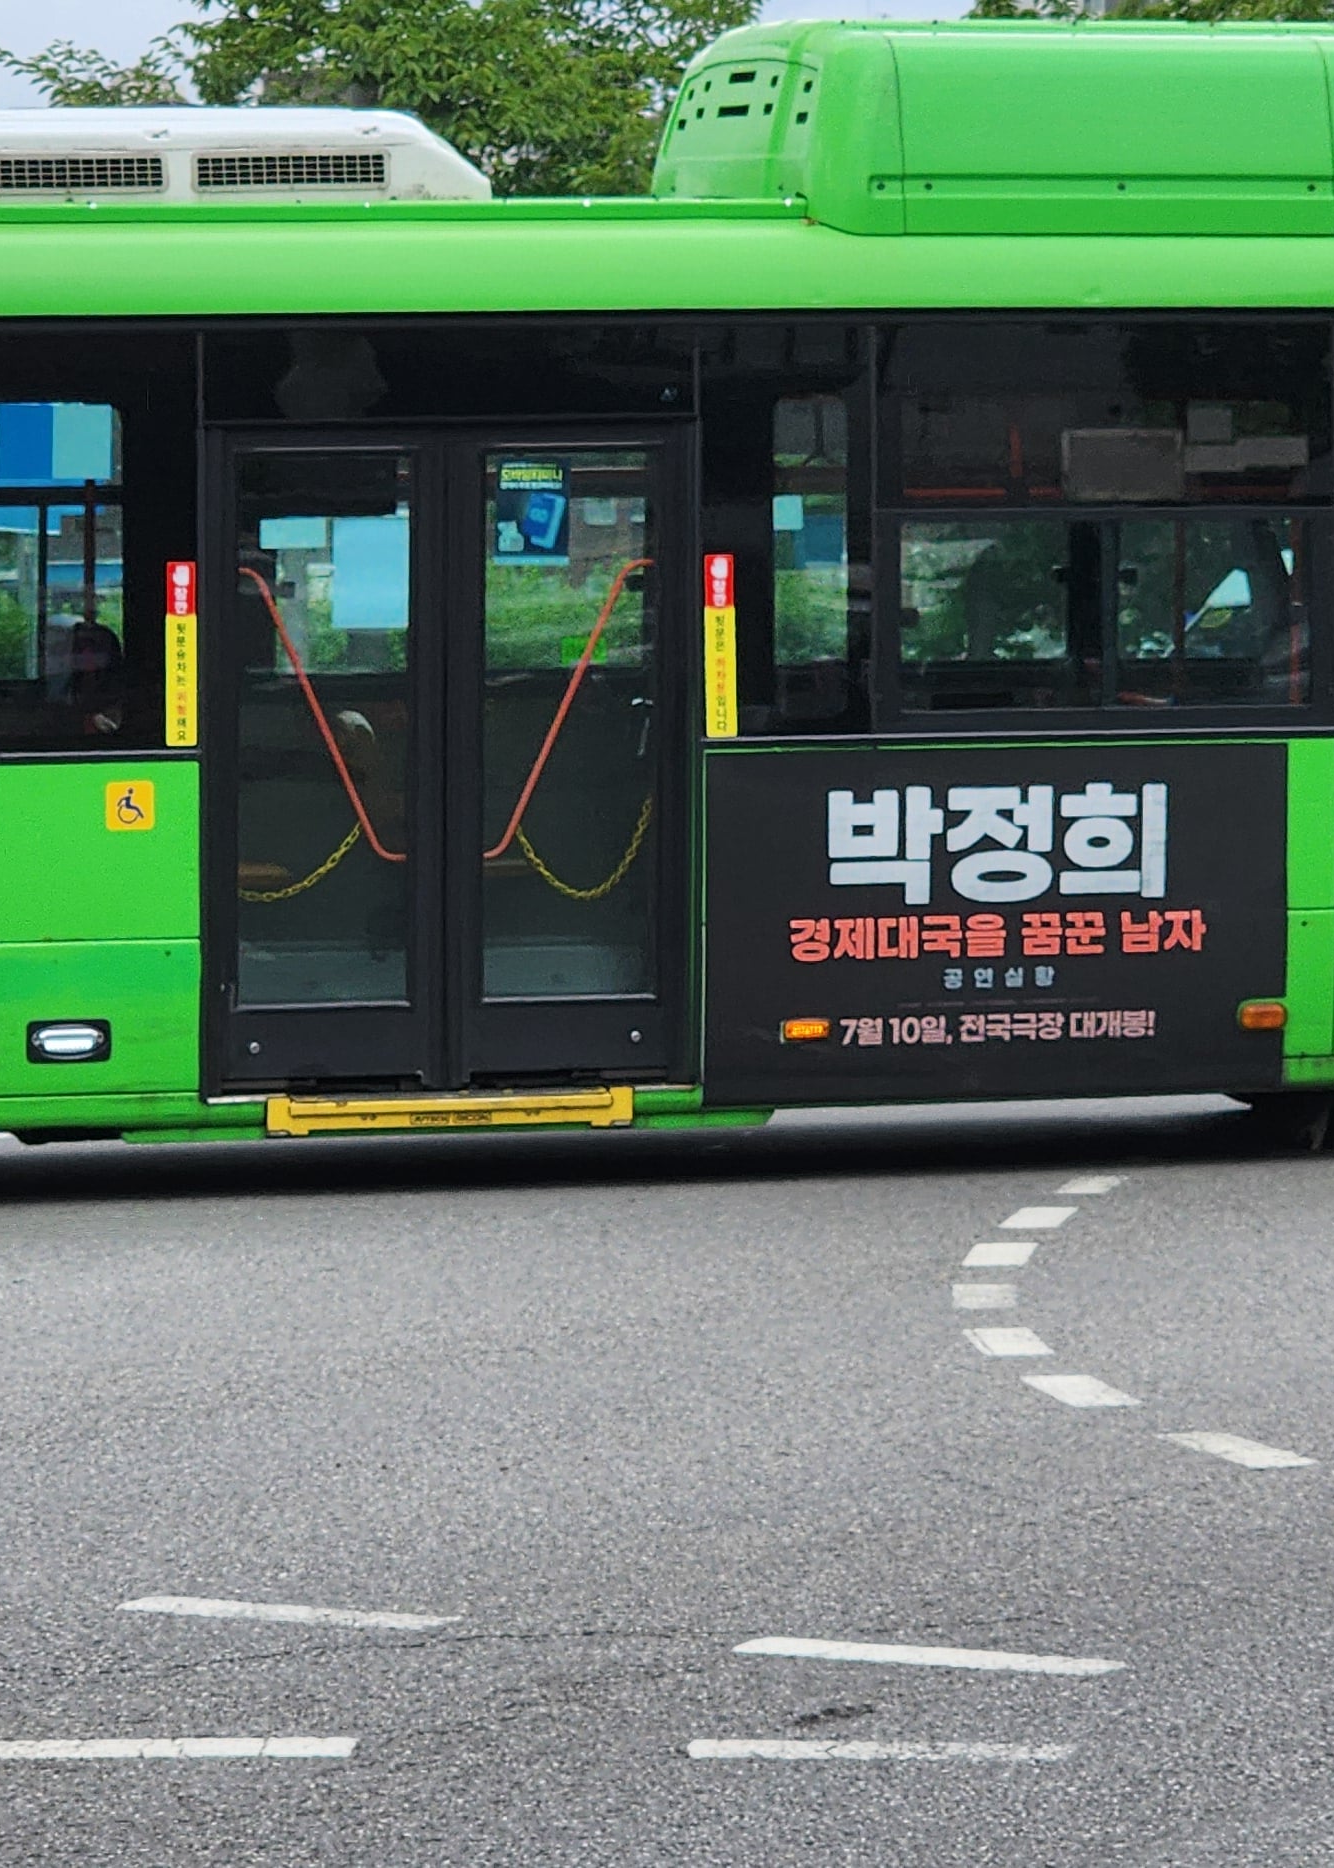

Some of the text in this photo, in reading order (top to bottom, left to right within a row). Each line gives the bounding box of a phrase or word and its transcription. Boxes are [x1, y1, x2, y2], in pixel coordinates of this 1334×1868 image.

[827, 782, 1168, 905] 박정희
[789, 909, 1207, 962] 경제대국을 꿈꾼 남자
[839, 1010, 1156, 1046] 7월 10일, 전국극장 대개봉!
